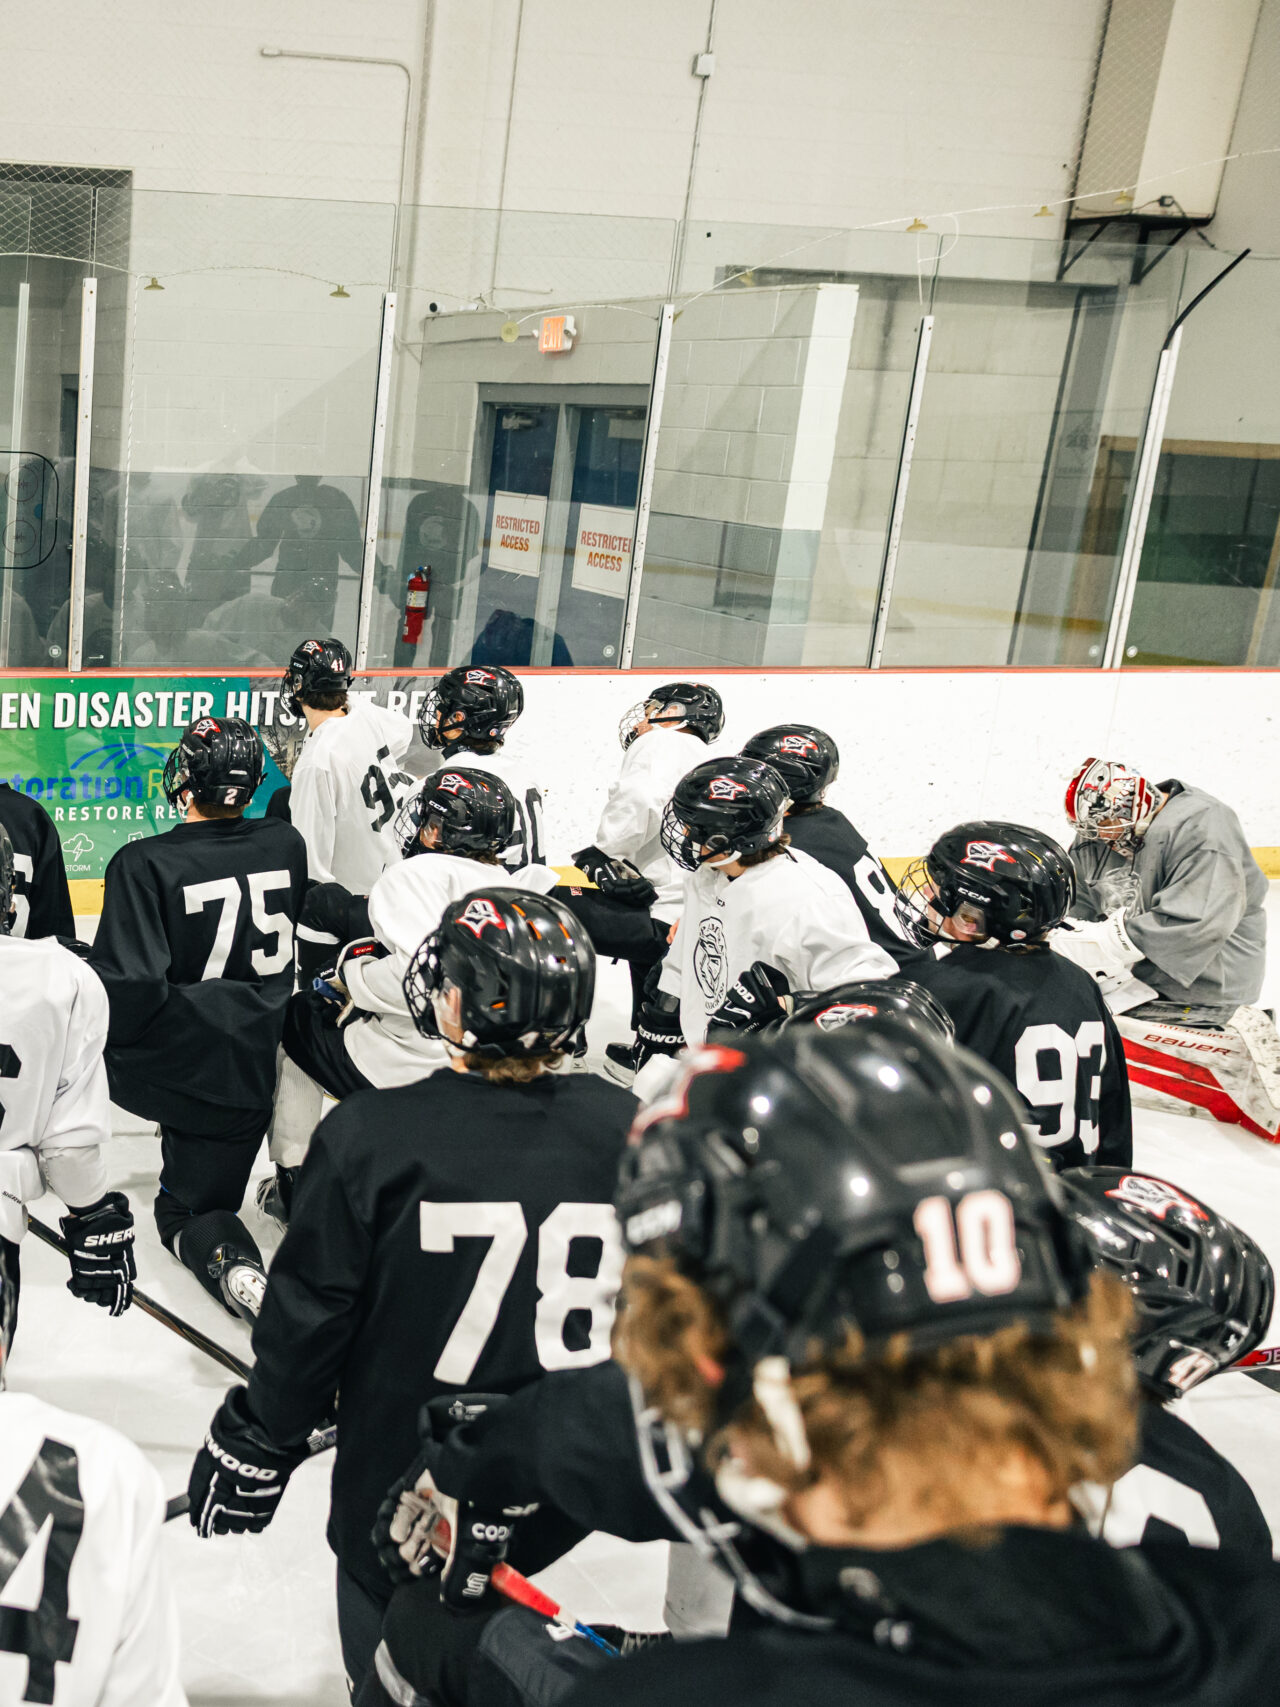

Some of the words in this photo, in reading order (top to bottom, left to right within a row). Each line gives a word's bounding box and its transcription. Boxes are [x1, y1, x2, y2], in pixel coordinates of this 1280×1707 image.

[543, 319, 562, 348] EXIT
[496, 515, 540, 535] RESTRICTED
[501, 534, 530, 552] ACCESS
[587, 551, 623, 573] ACCESS
[330, 658, 344, 673] 41
[53, 691, 214, 729] DISASTER
[223, 788, 239, 805] 2
[428, 800, 448, 813] CCM
[55, 805, 145, 821] RESTORE
[64, 864, 91, 872] STORM
[957, 886, 992, 904] CCM
[183, 869, 293, 982] 75
[1144, 1033, 1232, 1057] BAUER
[913, 1190, 1020, 1304] 10
[419, 1201, 621, 1386] 78
